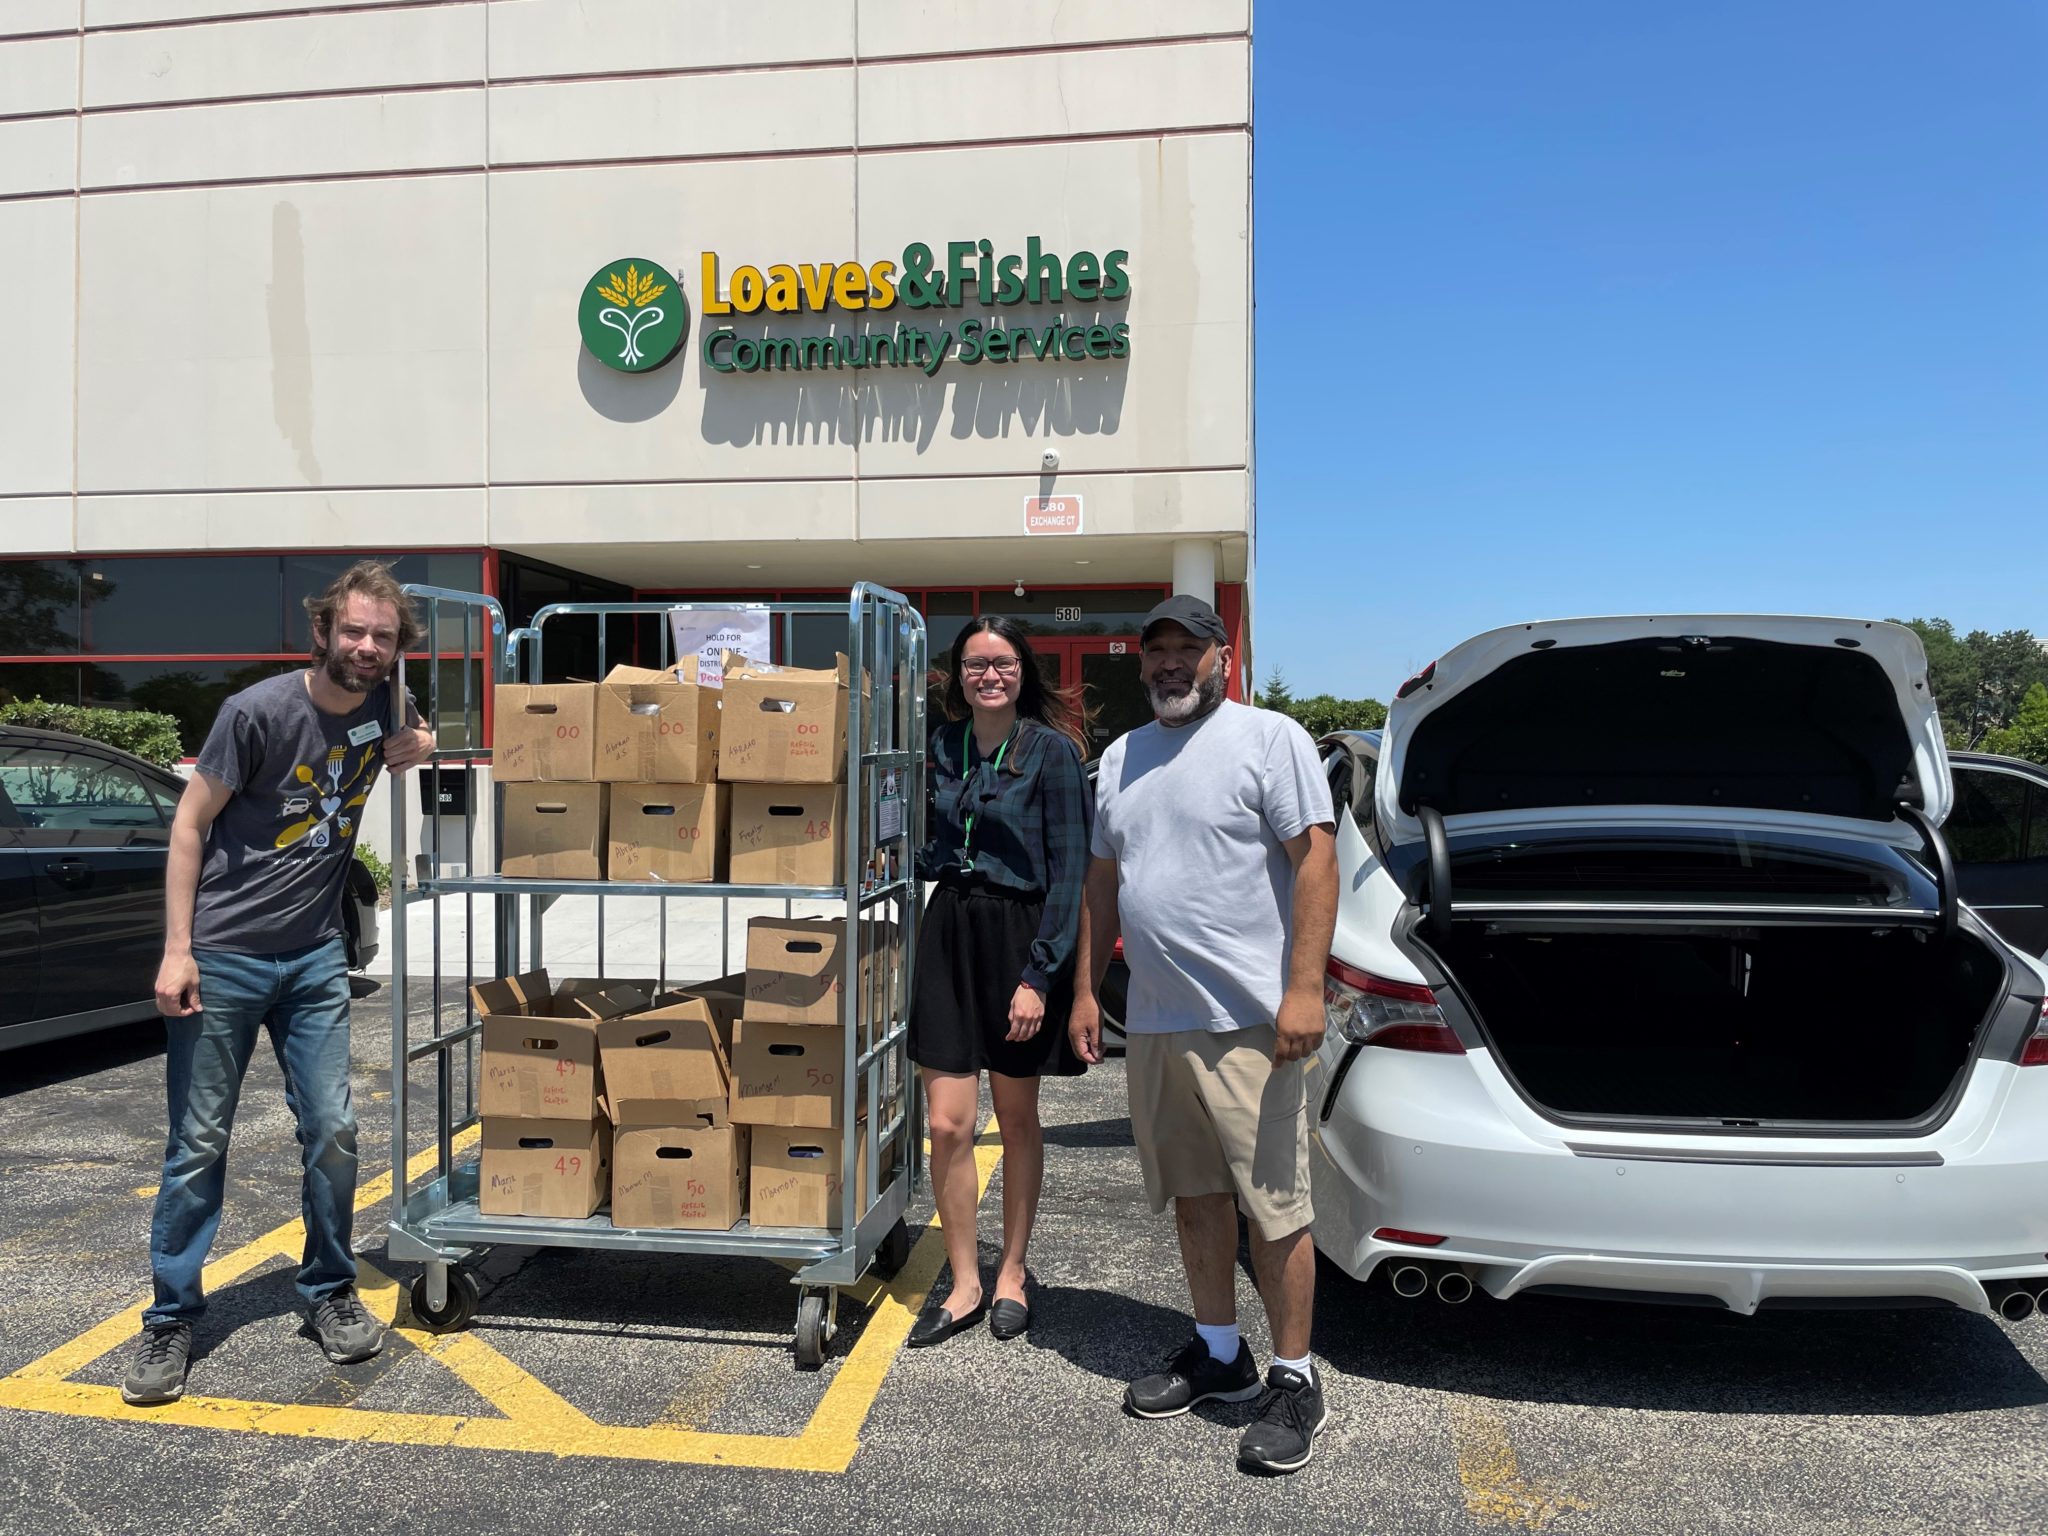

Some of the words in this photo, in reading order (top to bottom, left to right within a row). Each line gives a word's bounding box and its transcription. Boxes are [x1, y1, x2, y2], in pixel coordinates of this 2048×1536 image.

[701, 236, 1130, 316] Loaves&Fishes
[703, 325, 952, 377] Community
[958, 317, 1130, 364] Services
[1040, 502, 1066, 512] 580
[1030, 515, 1065, 527] EXCHANGE
[1066, 515, 1076, 526] CT
[1056, 608, 1080, 621] 580
[706, 634, 725, 642] HOLD
[726, 634, 742, 642] FOR
[440, 794, 452, 802] 580
[804, 819, 831, 841] 48
[820, 974, 845, 994] 50
[555, 1058, 577, 1077] 49
[806, 1068, 834, 1088] 50
[554, 1155, 581, 1177] 49
[686, 1179, 706, 1197] 50
